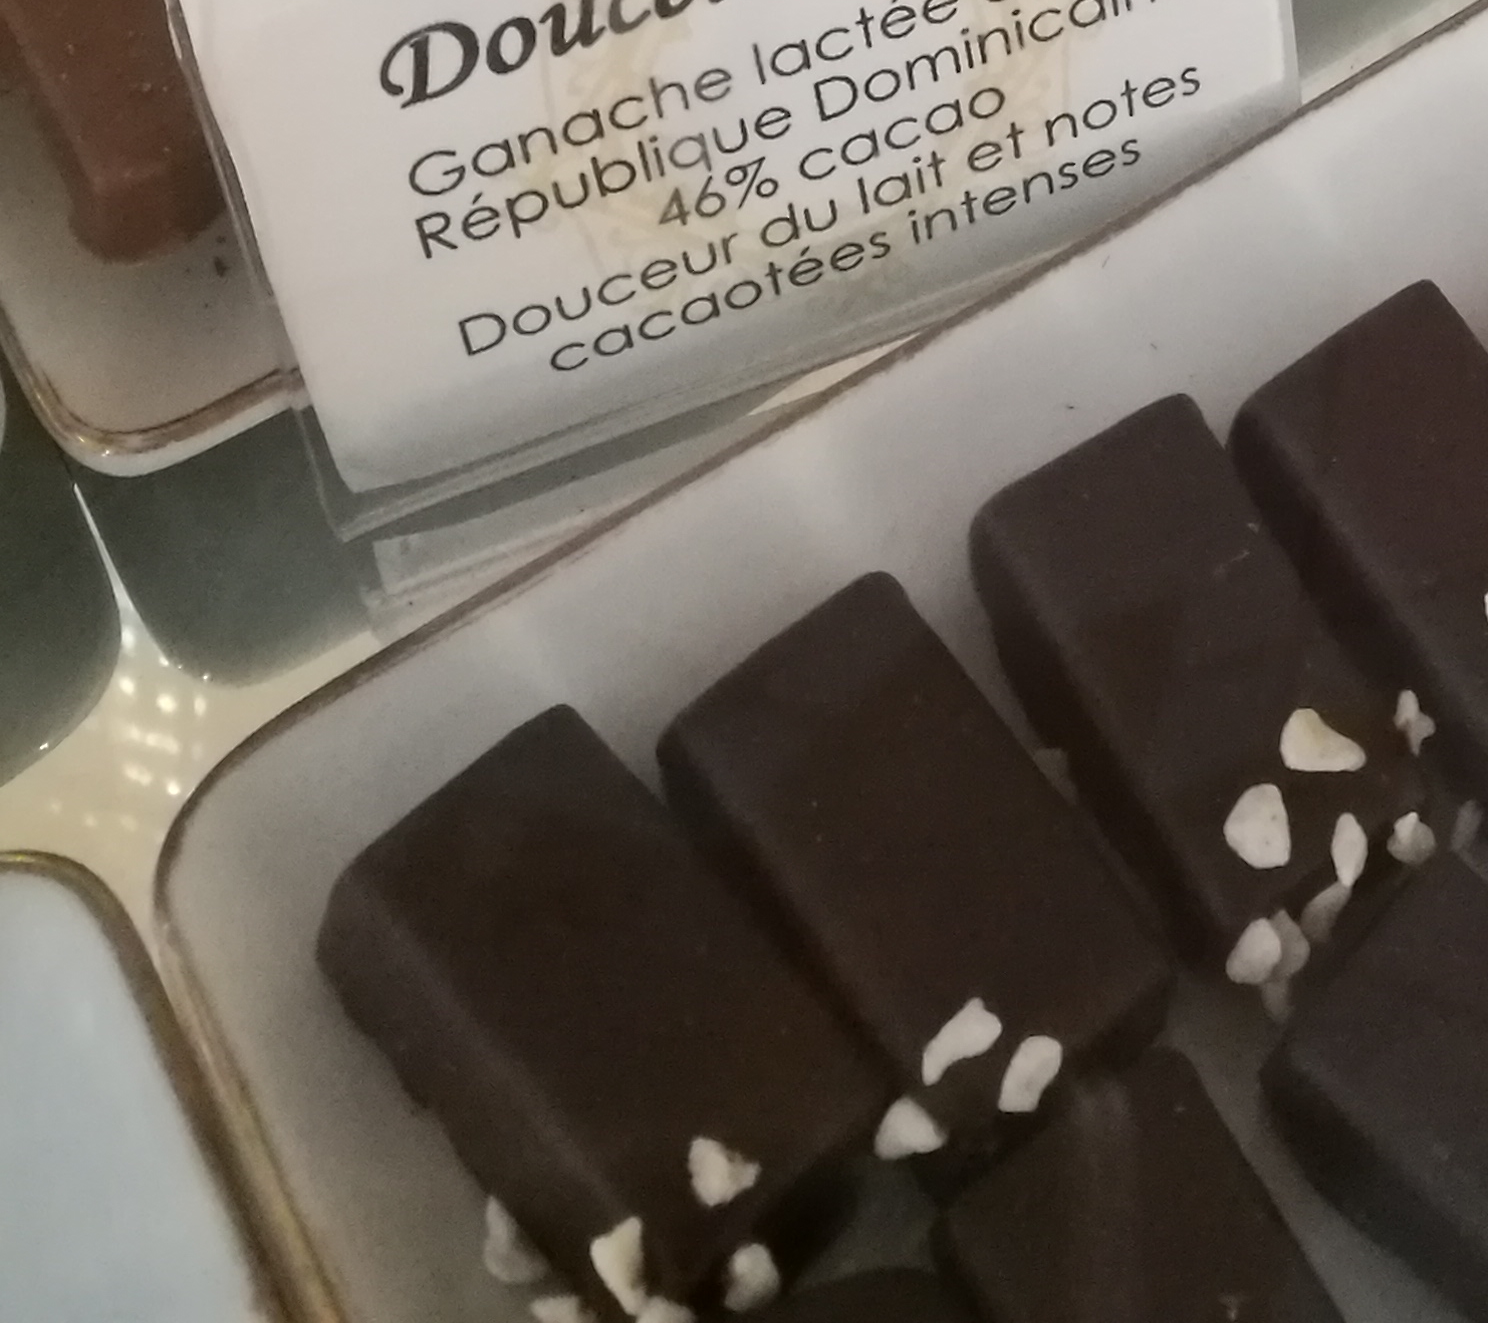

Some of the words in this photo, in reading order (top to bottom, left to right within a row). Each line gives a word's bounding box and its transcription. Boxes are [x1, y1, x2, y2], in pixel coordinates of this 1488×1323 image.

[409, 68, 732, 196] Ganache
[415, 107, 791, 259] République
[659, 156, 779, 226] 46%
[799, 87, 1006, 180] cacao
[458, 233, 738, 356] Douceur
[760, 199, 837, 247] du
[857, 151, 945, 214] lait
[967, 122, 1024, 172] et
[1045, 67, 1200, 147] notes
[550, 232, 891, 371] cacaotées
[908, 139, 1141, 245] intenses
